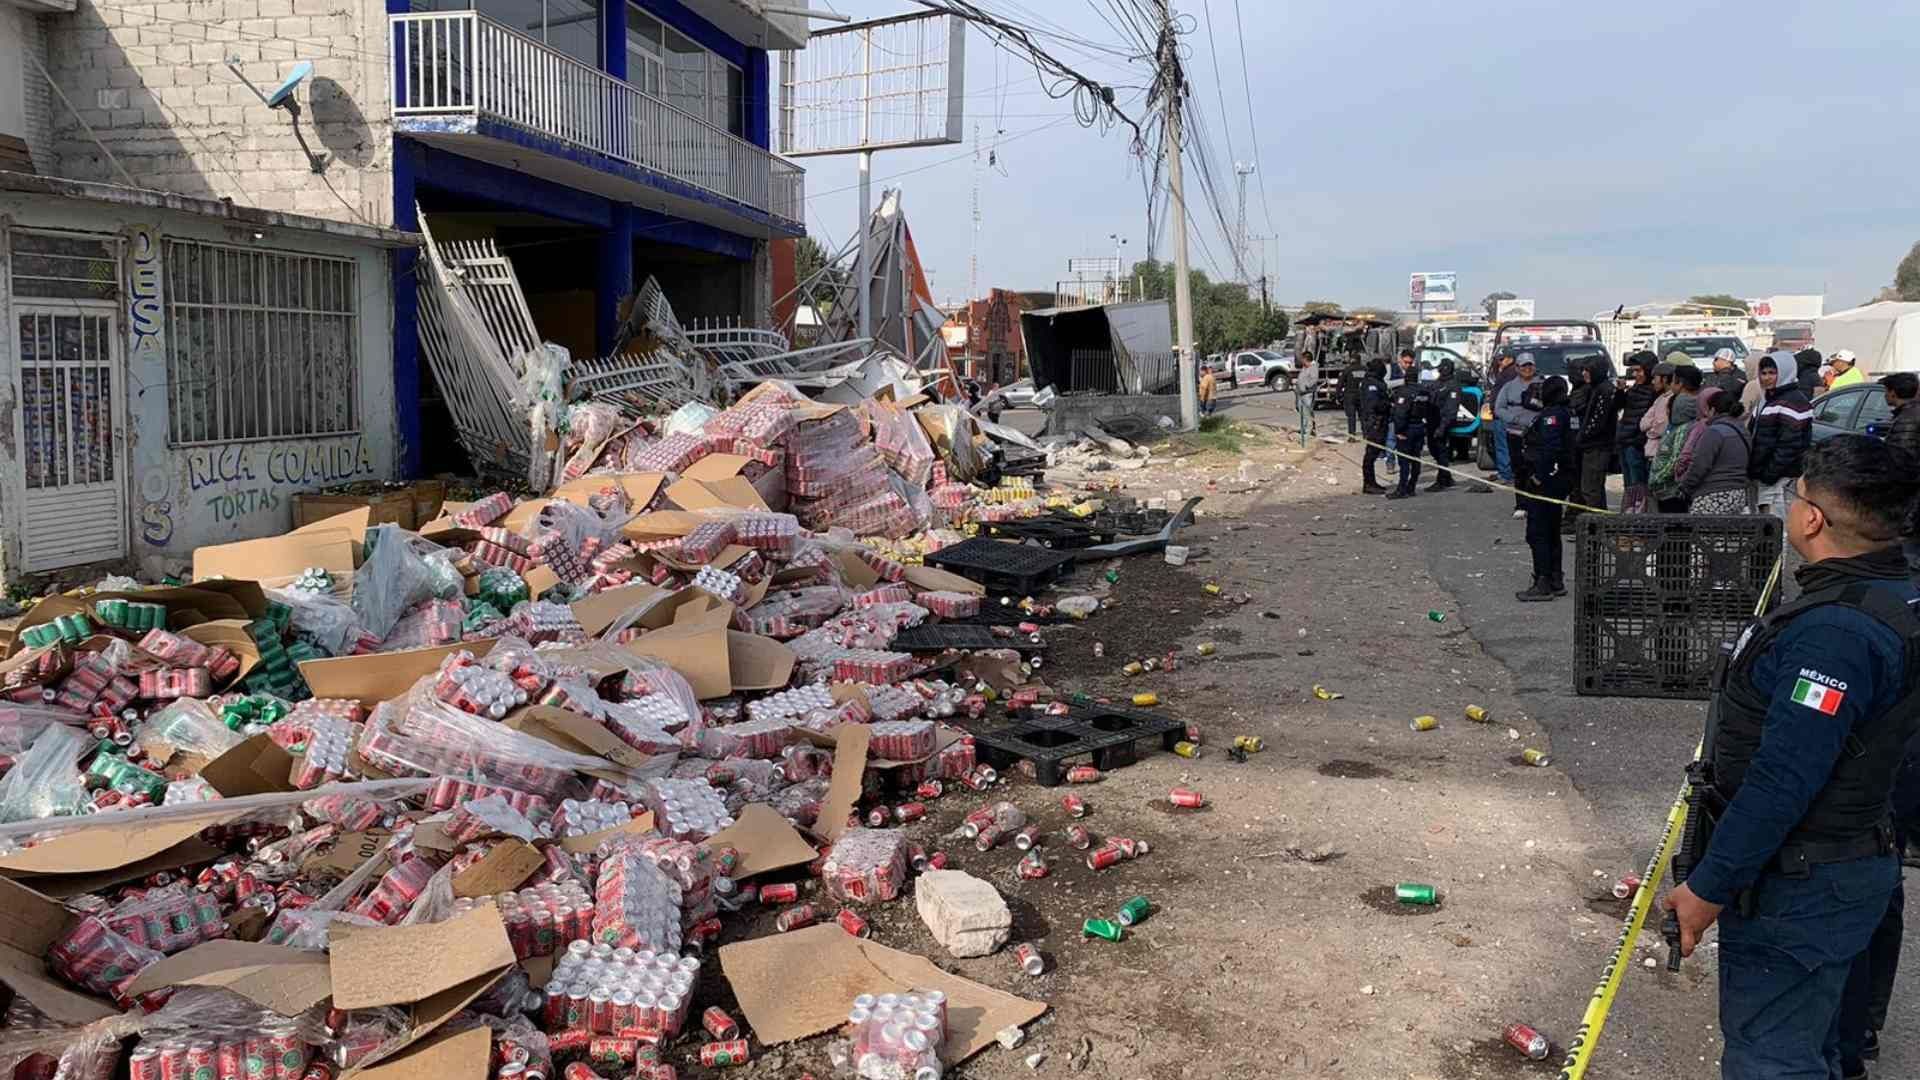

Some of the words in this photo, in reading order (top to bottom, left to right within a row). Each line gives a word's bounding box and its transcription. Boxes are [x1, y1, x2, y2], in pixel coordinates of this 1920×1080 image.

[188, 445, 256, 490] RICA
[267, 435, 374, 484] COMIDA
[207, 487, 280, 522] TORTAS
[1799, 667, 1848, 691] MÉXICO
